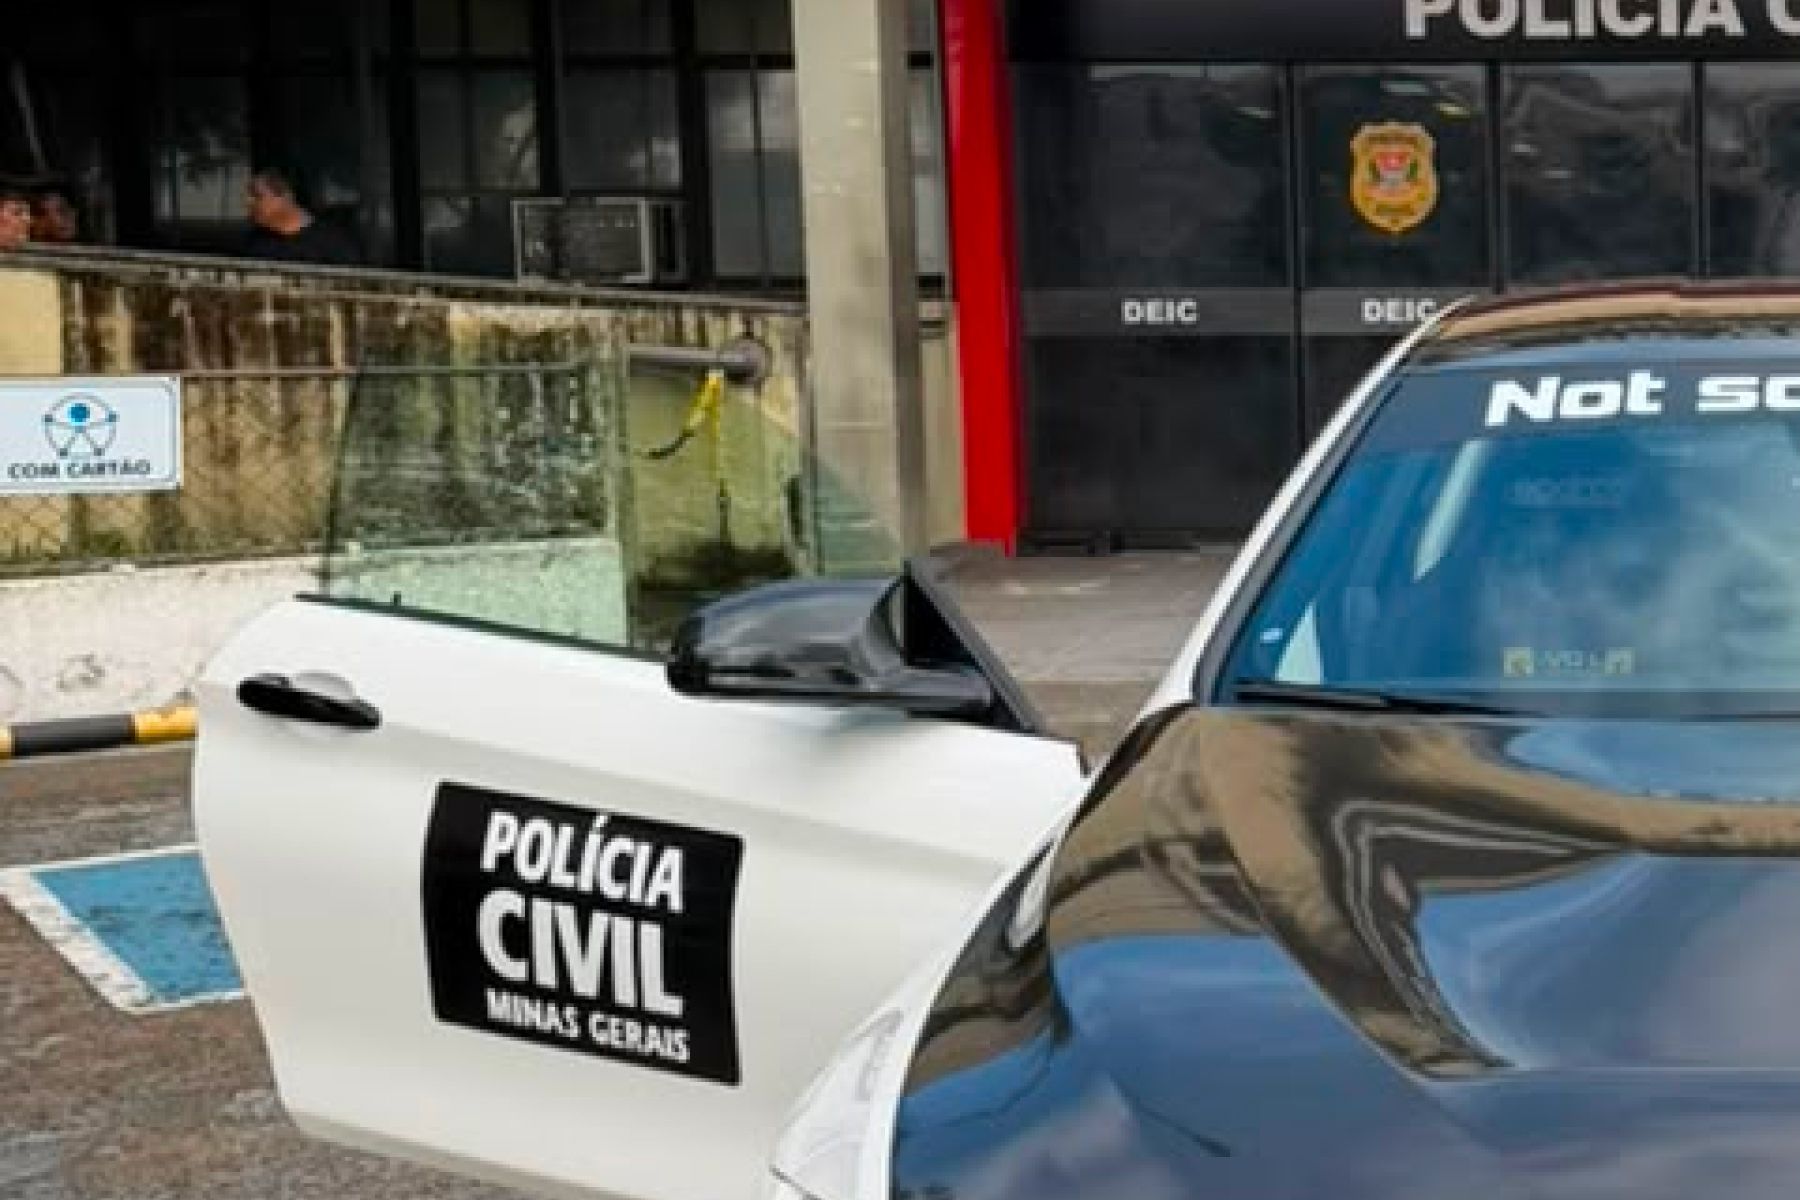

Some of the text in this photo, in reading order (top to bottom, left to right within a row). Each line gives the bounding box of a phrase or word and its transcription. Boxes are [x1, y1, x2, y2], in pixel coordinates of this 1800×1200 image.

[1121, 299, 1198, 325] DEIC
[1484, 370, 1664, 428] Not
[7, 462, 60, 479] COM
[480, 810, 686, 915] POLÍCIA
[477, 888, 686, 1018] CIVIL
[485, 987, 691, 1064] MINAS GERAIS
